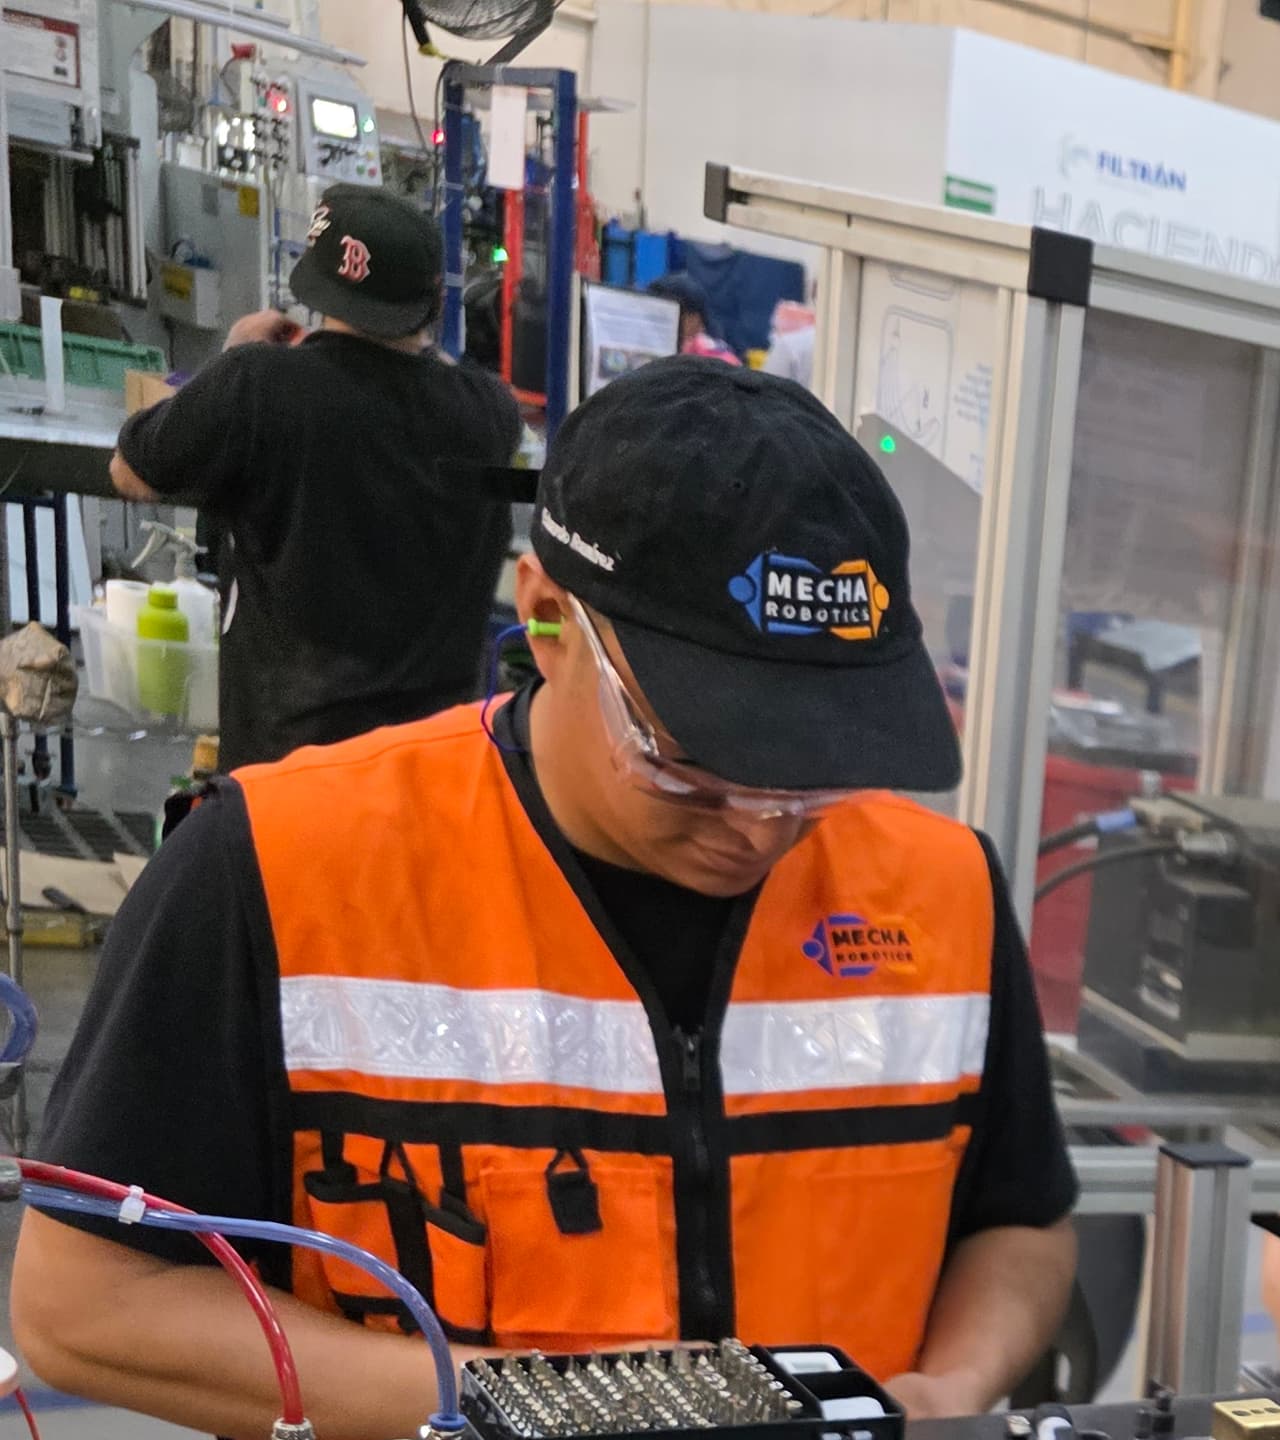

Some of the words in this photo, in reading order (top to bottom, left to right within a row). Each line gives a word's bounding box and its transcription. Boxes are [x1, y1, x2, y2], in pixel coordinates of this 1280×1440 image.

[338, 234, 371, 283] B
[767, 571, 868, 603] MECHA
[765, 601, 870, 622] ROBOTICS
[832, 929, 910, 946] MECHA
[836, 952, 913, 962] ROBOTICS
